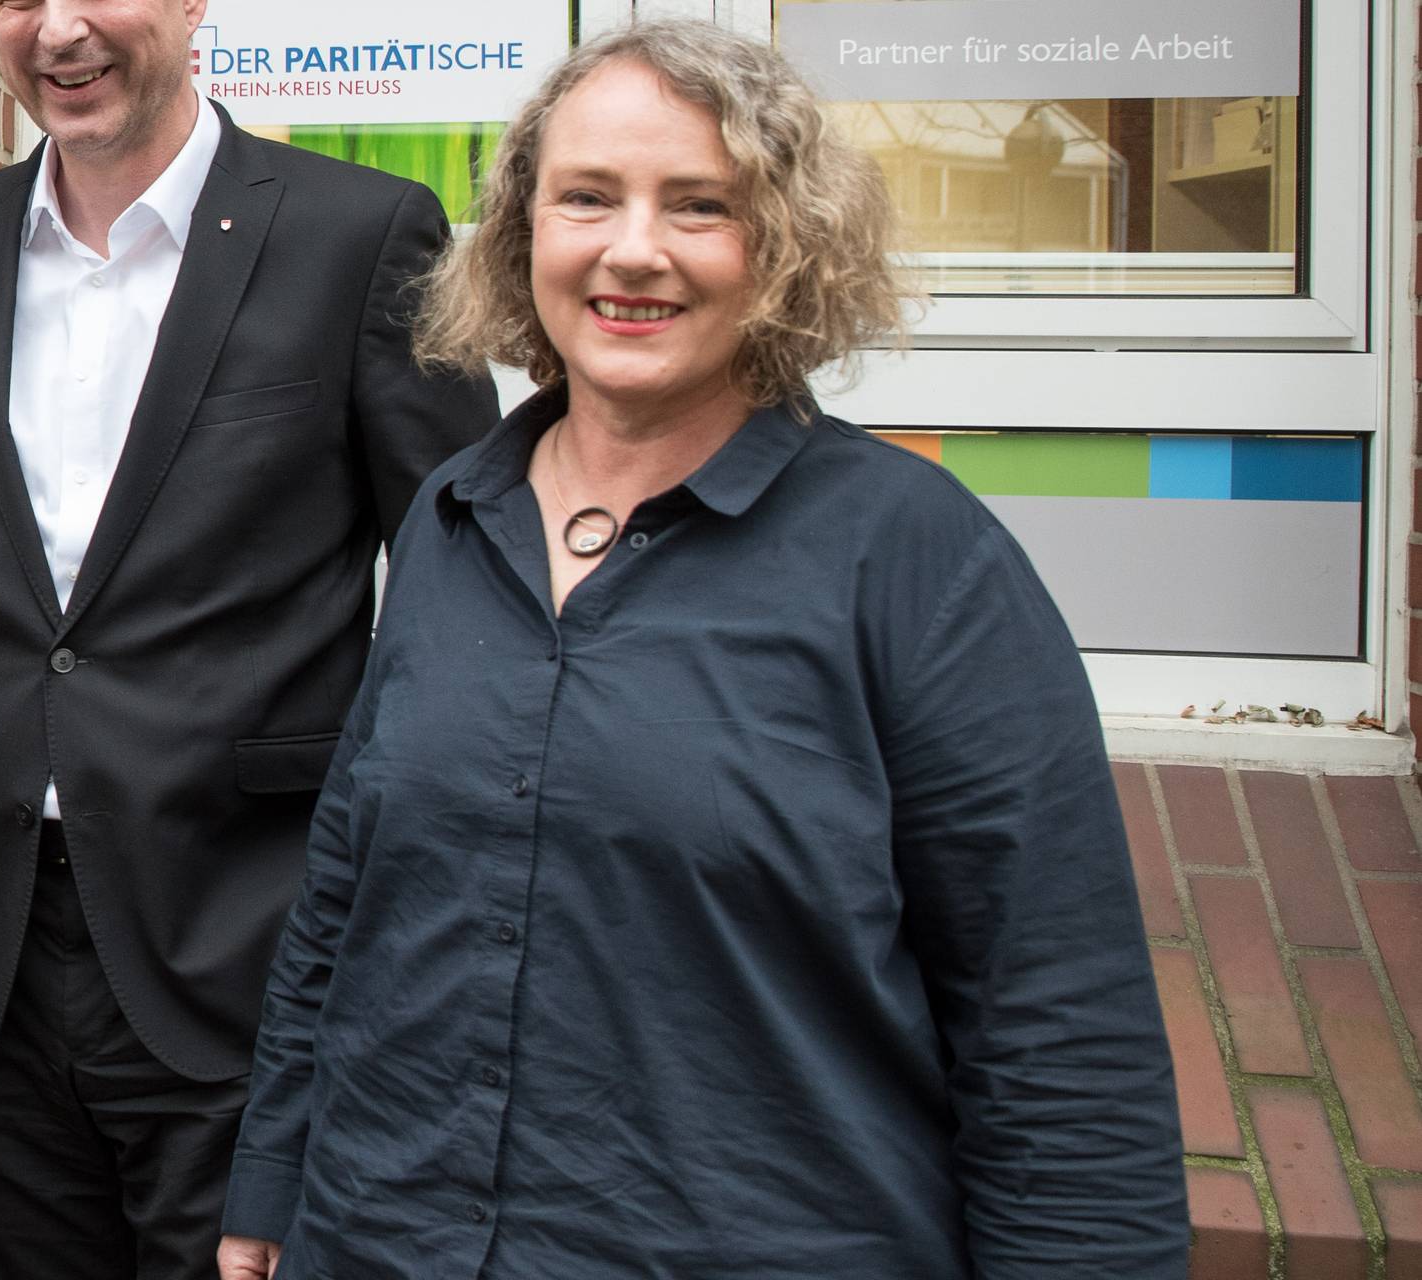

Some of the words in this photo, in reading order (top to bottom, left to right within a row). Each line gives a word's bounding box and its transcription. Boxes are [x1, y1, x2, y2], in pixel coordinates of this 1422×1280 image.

[210, 48, 274, 74] DER
[285, 40, 524, 73] PARITÄTISCHE
[839, 39, 952, 65] Partner
[962, 37, 1007, 64] für
[1017, 35, 1121, 62] soziale
[1130, 34, 1234, 60] Arbeit
[211, 81, 331, 98] RHEIN-KREIS
[338, 79, 401, 95] NEUSS
